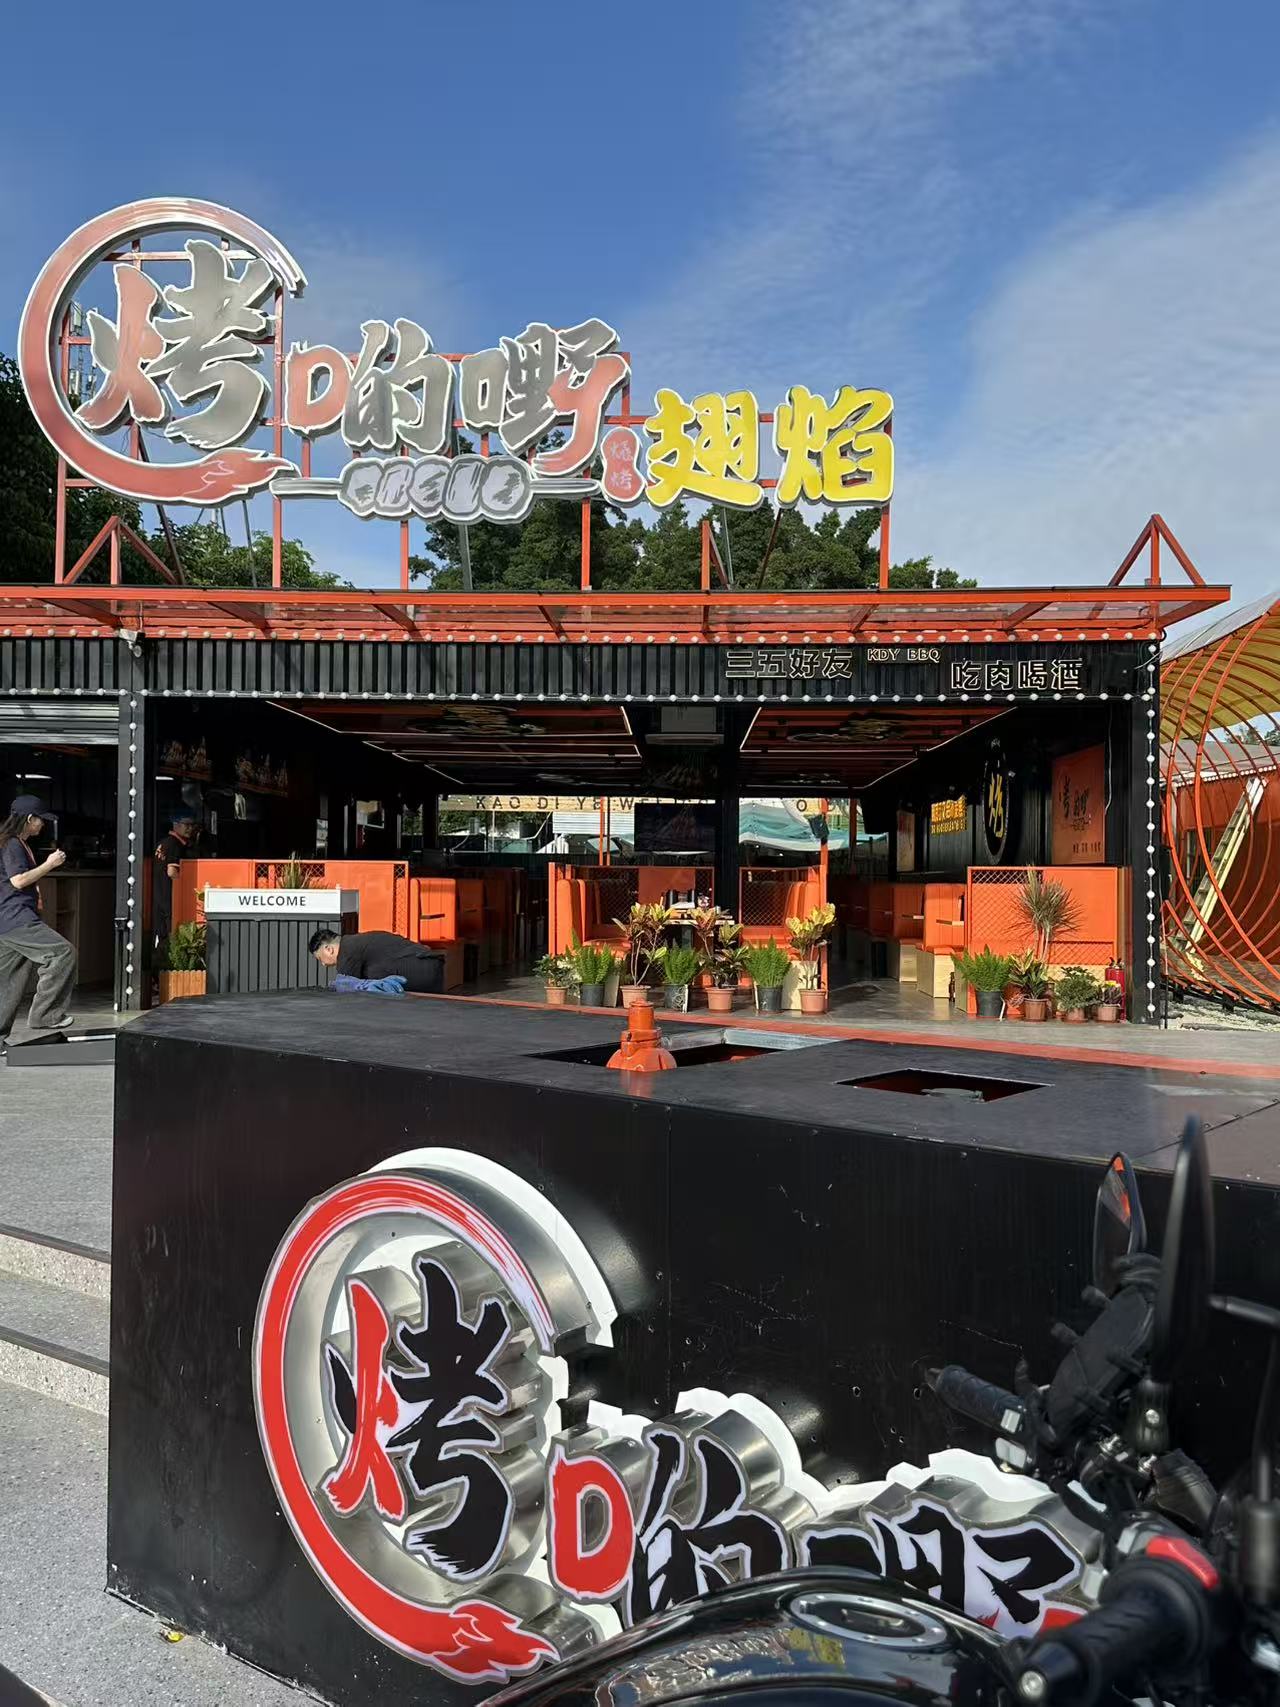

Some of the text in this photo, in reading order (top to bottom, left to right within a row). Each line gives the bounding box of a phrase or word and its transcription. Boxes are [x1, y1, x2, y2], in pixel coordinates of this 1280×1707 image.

[867, 648, 942, 663] KDY BBQ
[725, 648, 853, 679] 三五好友
[951, 659, 1083, 691] 吃肉喝酒
[476, 797, 521, 809] KAO
[238, 895, 307, 907] WELCOME
